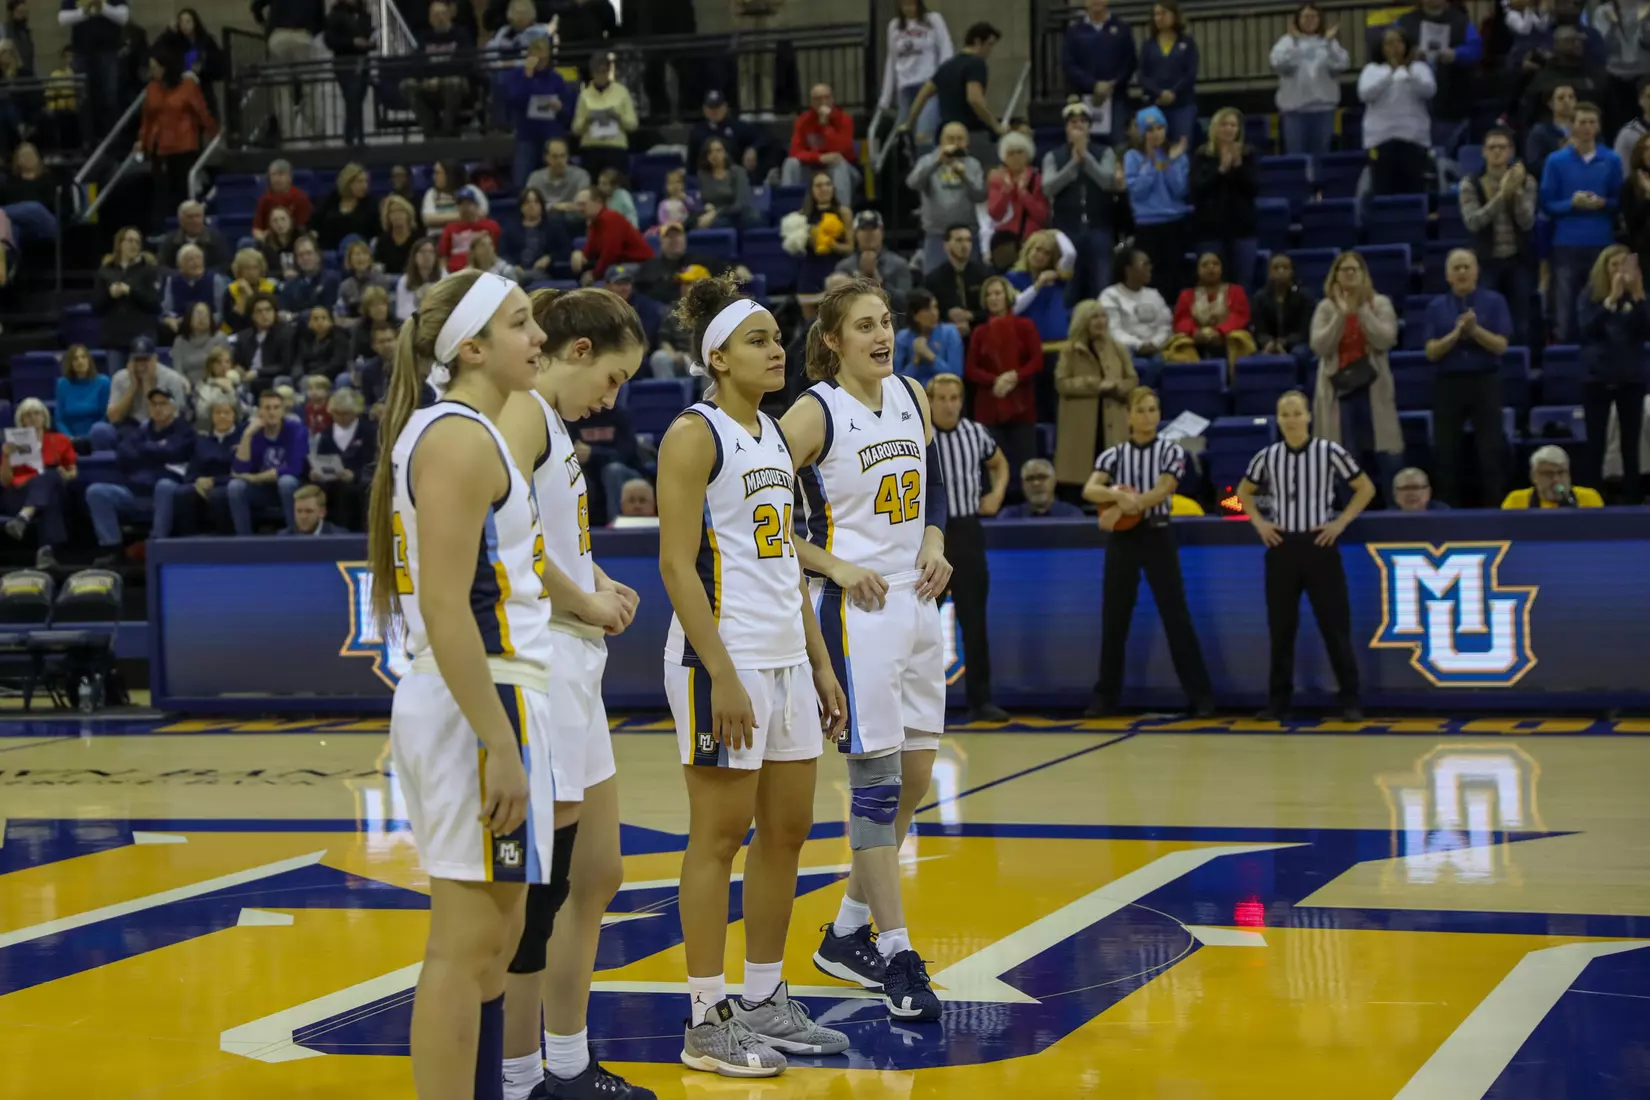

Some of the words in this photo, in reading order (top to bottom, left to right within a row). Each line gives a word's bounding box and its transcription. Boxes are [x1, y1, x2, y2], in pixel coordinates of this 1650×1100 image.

[858, 439, 921, 474] MARQUETTE
[874, 469, 920, 525] 42
[1382, 550, 1526, 678] MU
[699, 734, 715, 751] MU
[498, 841, 521, 866] MU
